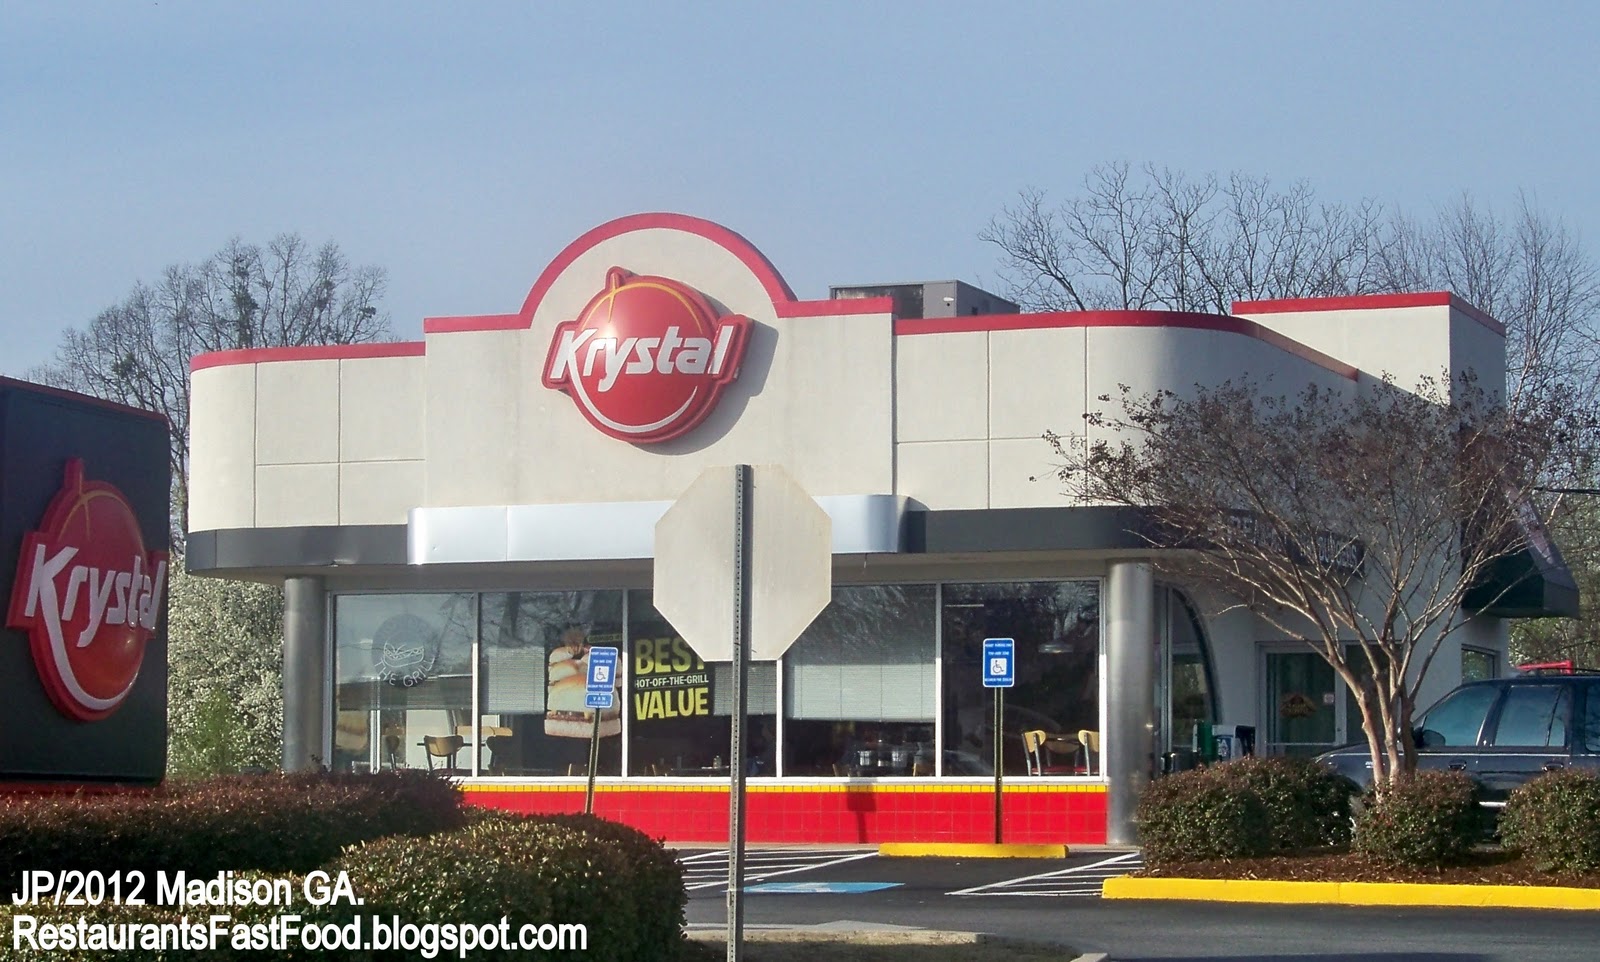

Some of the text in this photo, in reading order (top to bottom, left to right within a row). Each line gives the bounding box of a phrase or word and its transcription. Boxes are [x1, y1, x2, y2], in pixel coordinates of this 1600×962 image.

[550, 325, 735, 392] Krystal
[24, 543, 166, 647] Krystal
[373, 656, 436, 687] THE GRILL
[635, 674, 709, 689] HOT-OFF-THE-GRILL
[635, 687, 709, 720] VALUE
